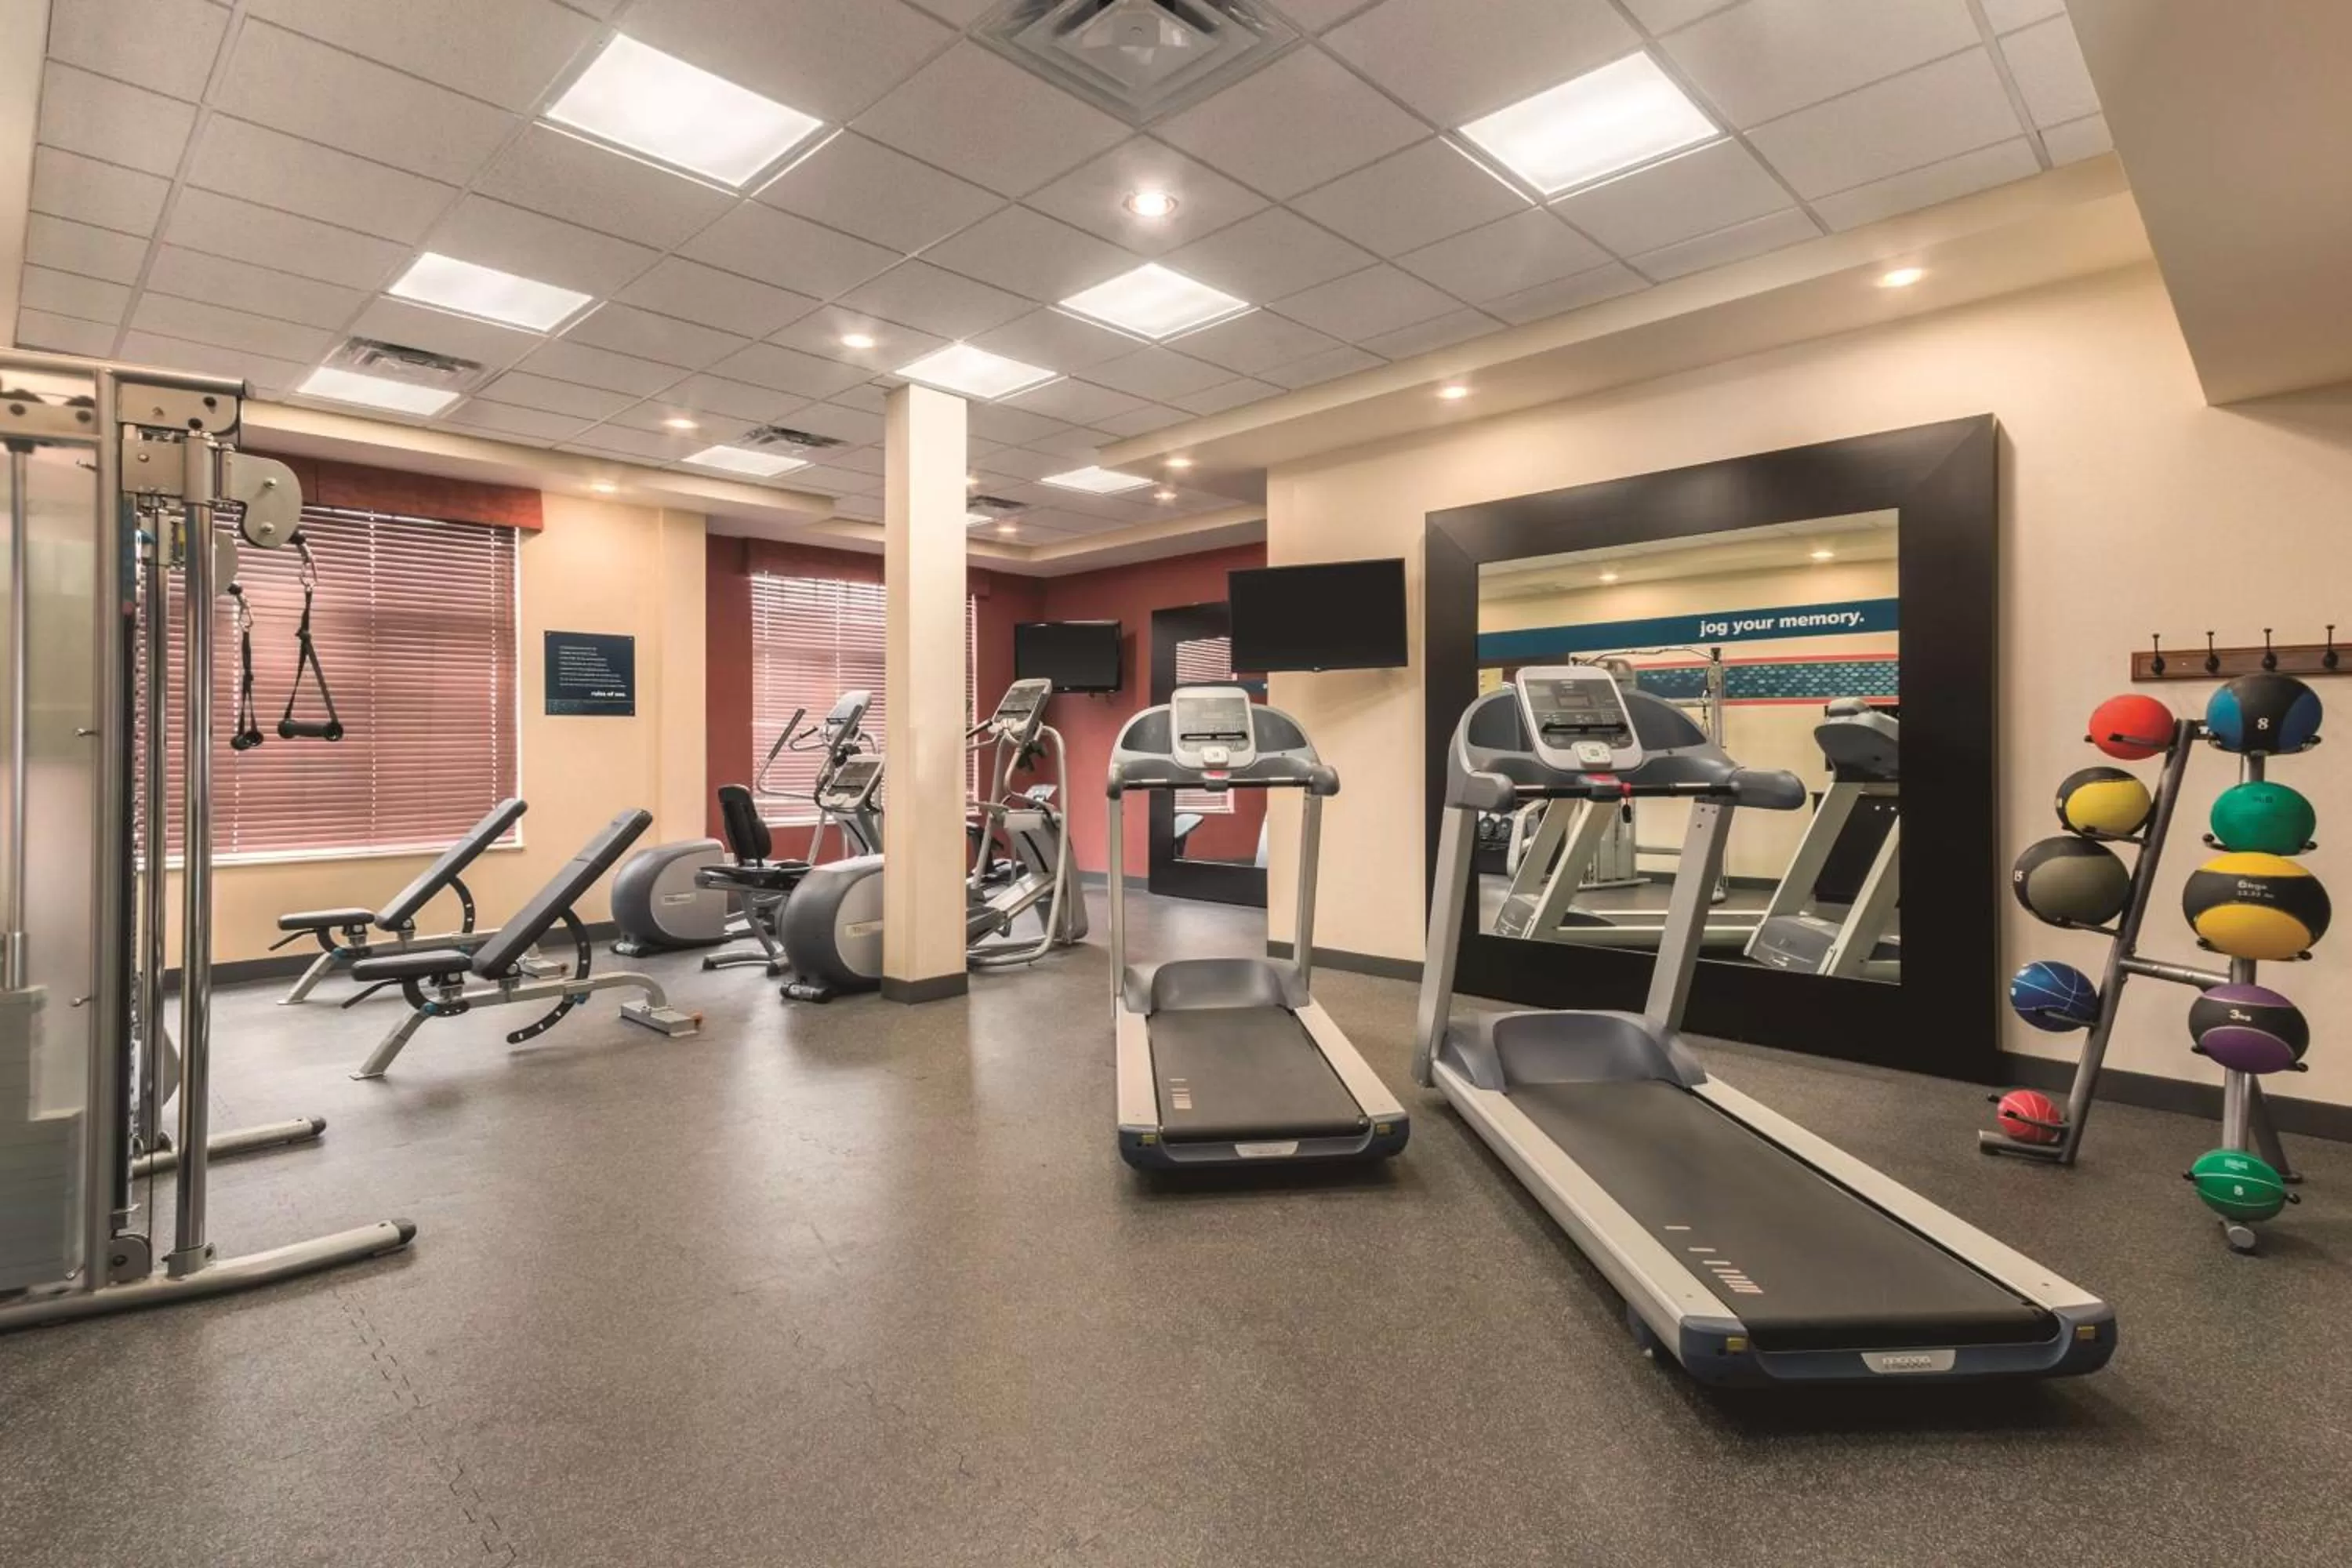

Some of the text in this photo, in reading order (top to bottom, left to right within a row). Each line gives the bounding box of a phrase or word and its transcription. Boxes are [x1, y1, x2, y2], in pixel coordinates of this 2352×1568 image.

[1699, 611, 1865, 637] jog your memory.
[2257, 717, 2269, 730] 8
